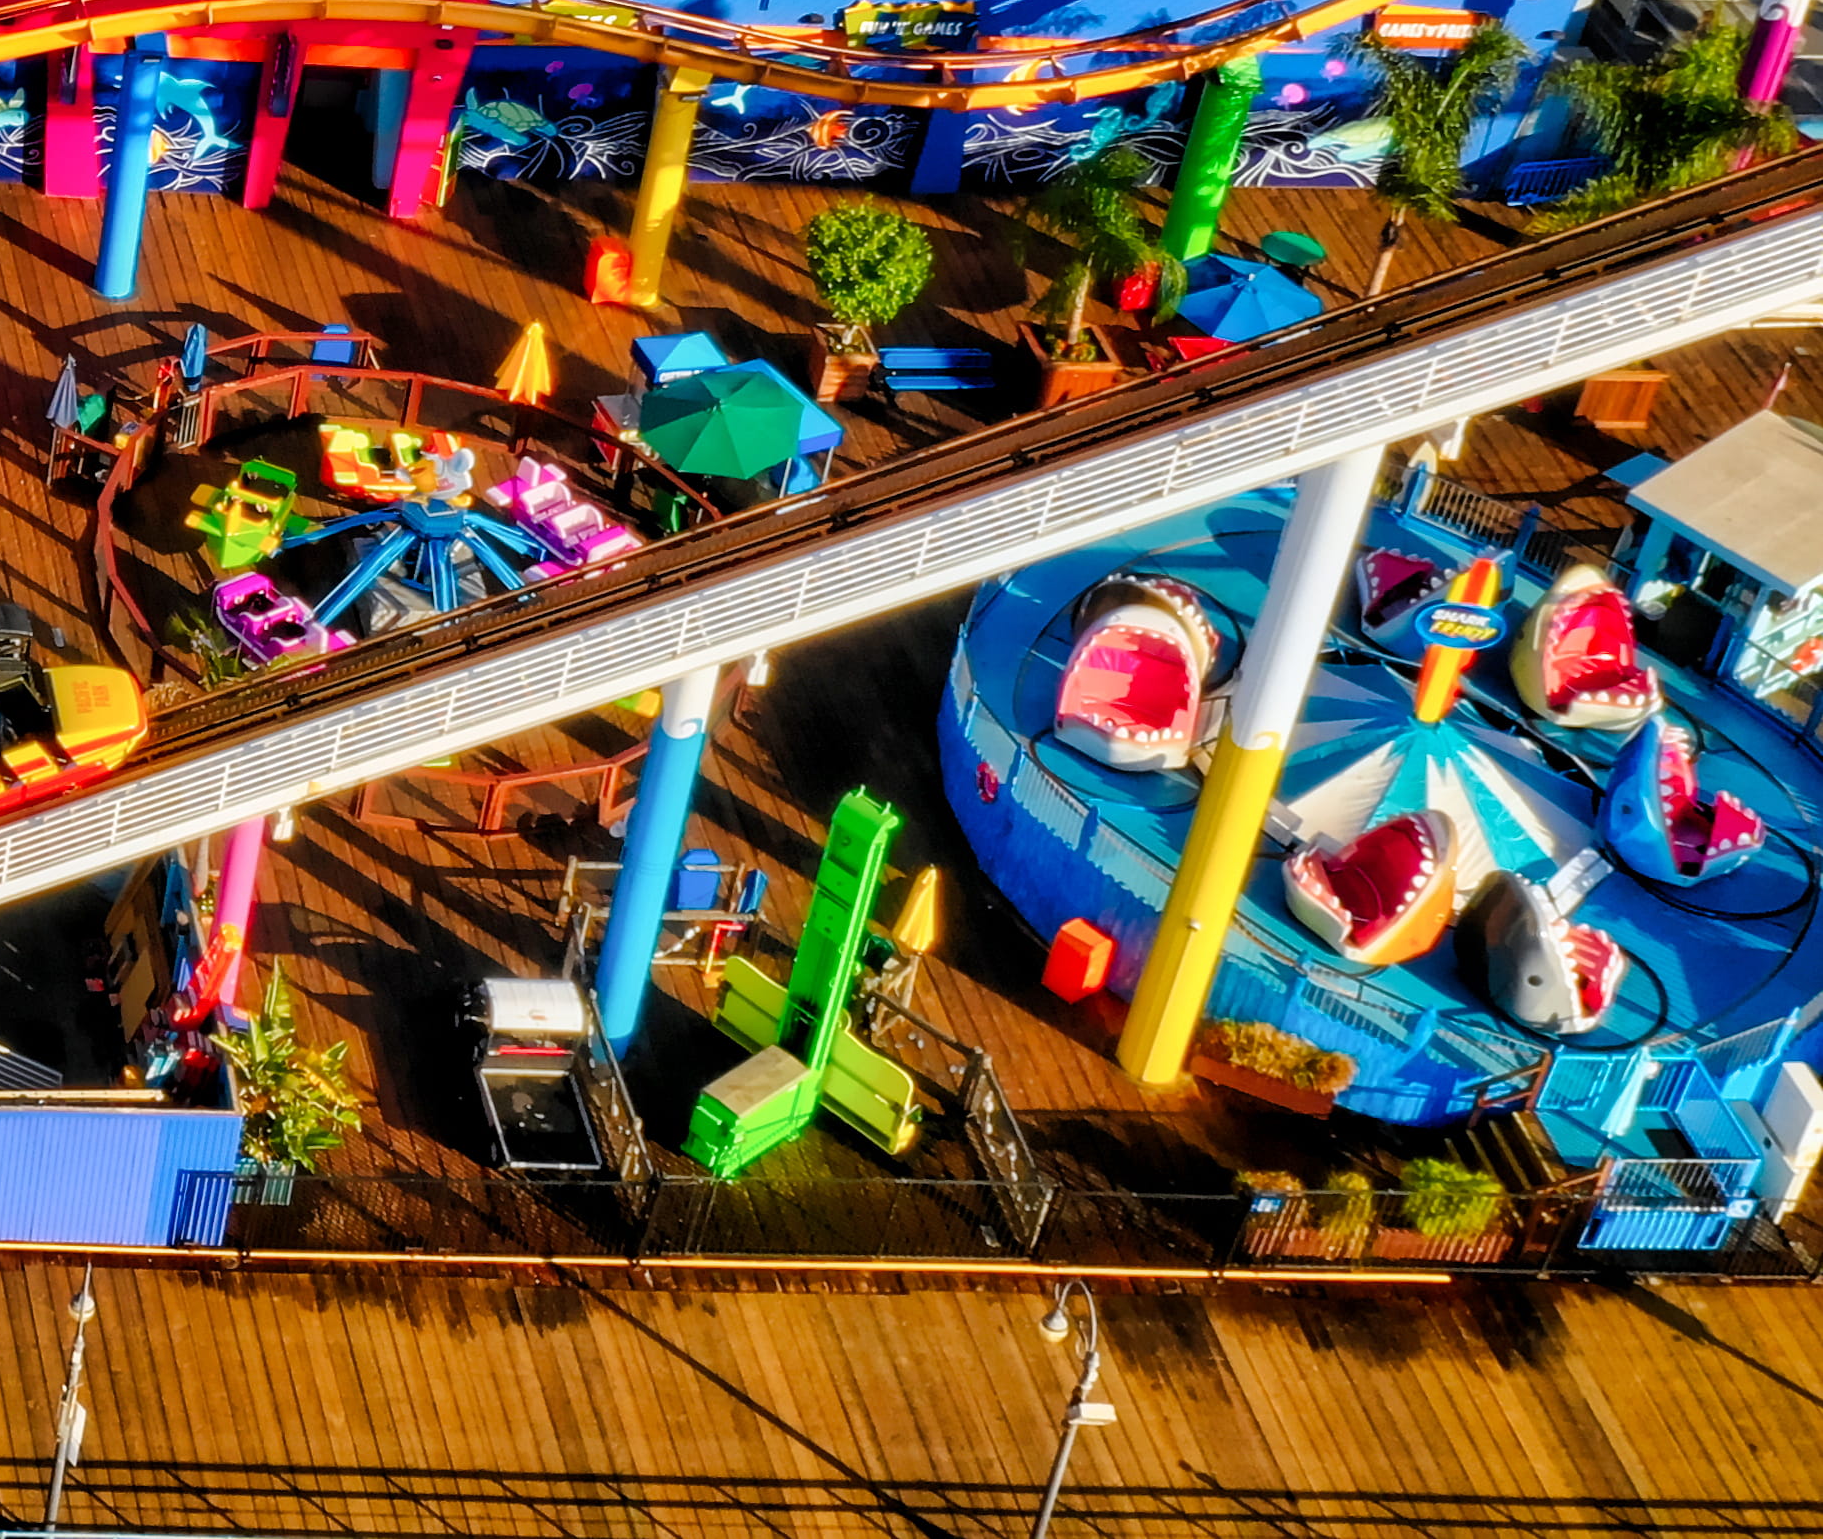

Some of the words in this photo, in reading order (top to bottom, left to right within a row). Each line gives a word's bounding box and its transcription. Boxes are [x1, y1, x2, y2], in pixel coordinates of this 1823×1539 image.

[913, 21, 963, 36] GAMES
[1379, 23, 1425, 38] GAMES
[1431, 609, 1491, 628] SHARK
[1429, 620, 1498, 642] FRENZY
[72, 680, 93, 714] PACIFIC
[92, 685, 112, 708] PARK
